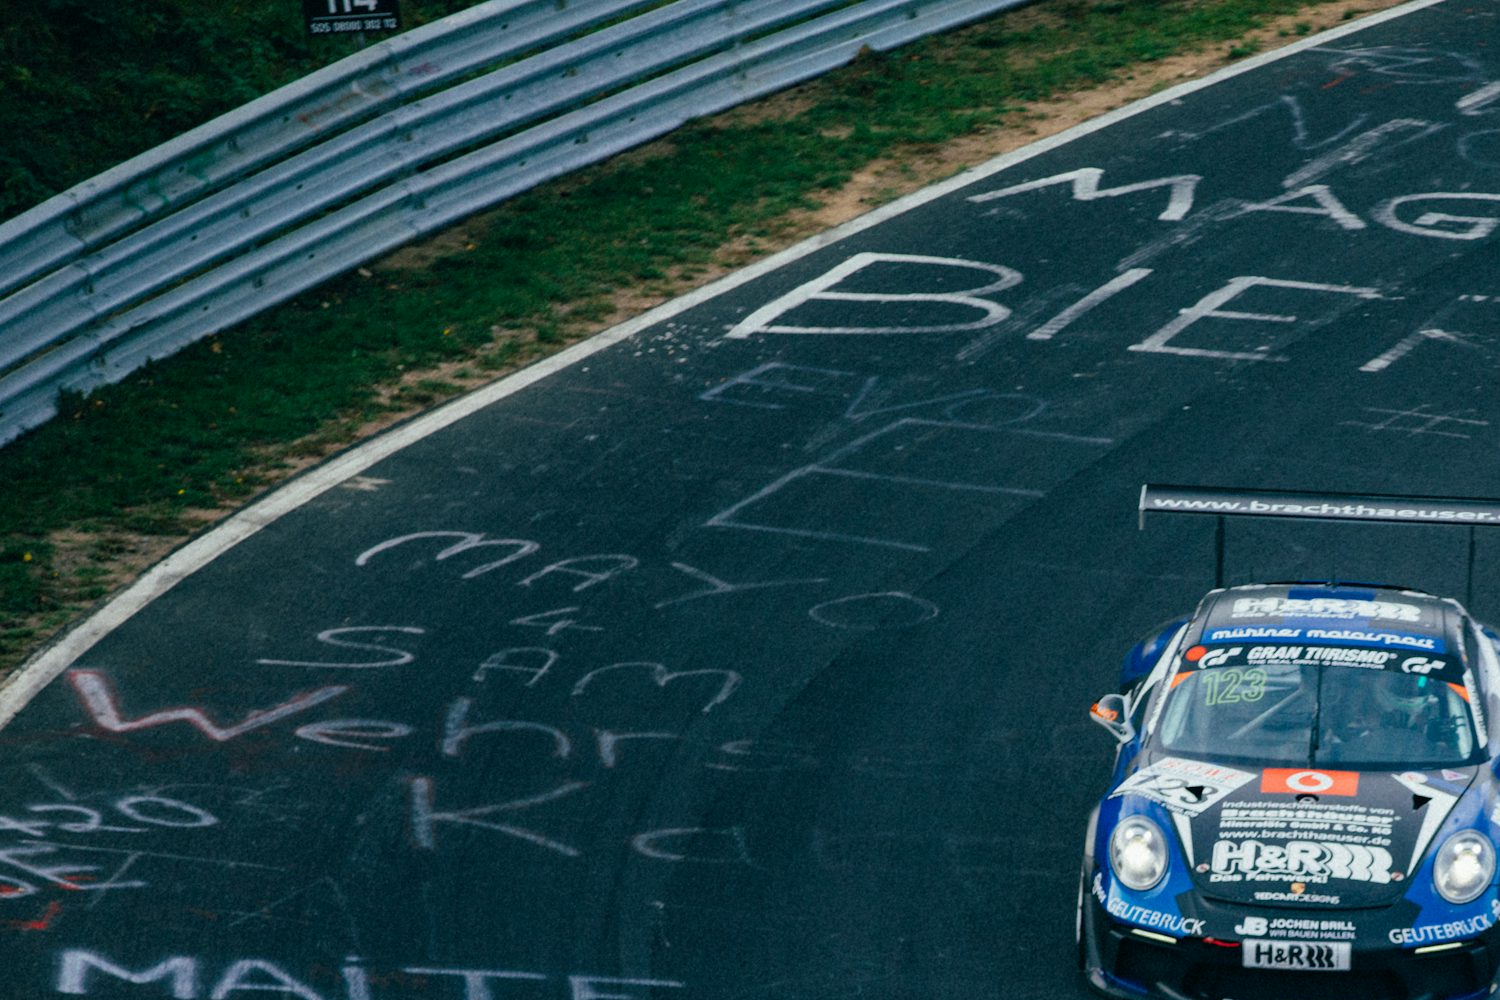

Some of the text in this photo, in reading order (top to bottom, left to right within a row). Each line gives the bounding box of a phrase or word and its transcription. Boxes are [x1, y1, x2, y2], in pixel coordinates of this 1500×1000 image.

[1247, 646, 1302, 661] GRAN
[1202, 668, 1267, 706] 123
[1222, 801, 1394, 815] Industrieschmierstoffe von
[1290, 821, 1330, 831] GmbH
[1333, 823, 1344, 832] &
[1372, 827, 1392, 836] KG
[1219, 830, 1392, 846] www.brachthaeuser.de
[1210, 874, 1242, 883] Das
[1270, 918, 1319, 930] JOCHEN
[1321, 920, 1356, 931] BRILL
